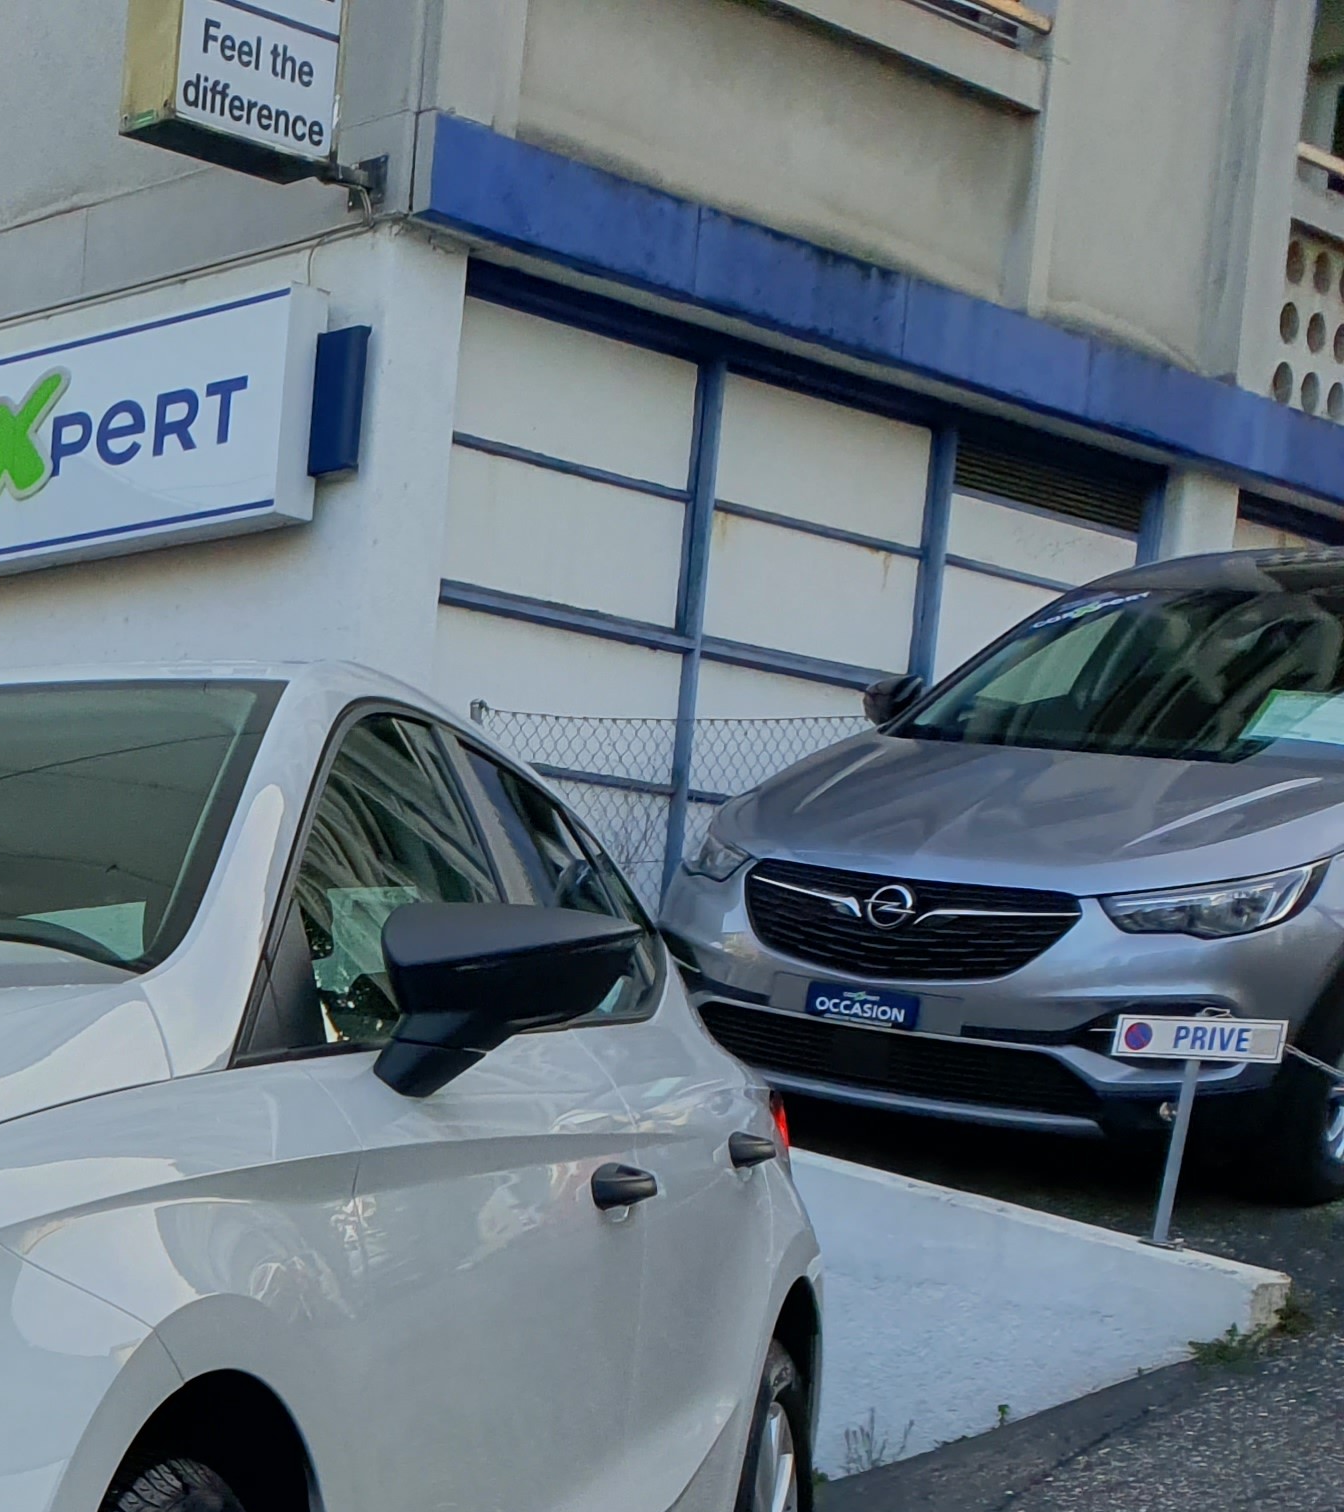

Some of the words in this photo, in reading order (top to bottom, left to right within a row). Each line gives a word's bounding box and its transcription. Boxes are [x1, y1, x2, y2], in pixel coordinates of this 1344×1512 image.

[201, 17, 262, 71] Feel
[270, 42, 314, 88] the
[182, 73, 324, 147] difference
[815, 996, 905, 1023] OCCASION
[1173, 1025, 1252, 1052] PRIVE
